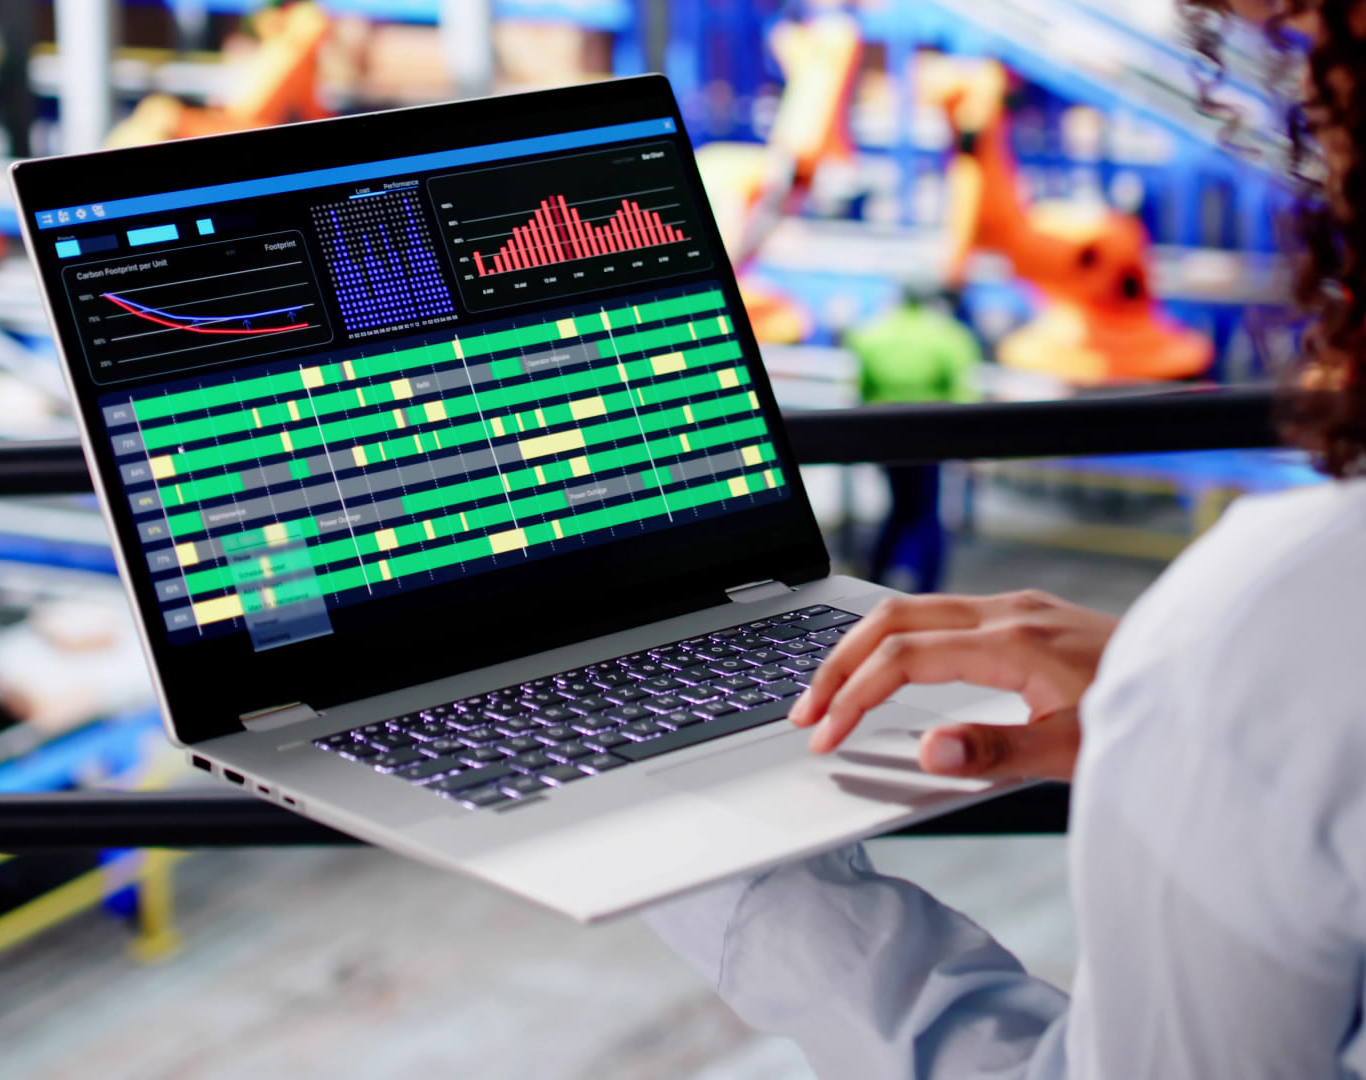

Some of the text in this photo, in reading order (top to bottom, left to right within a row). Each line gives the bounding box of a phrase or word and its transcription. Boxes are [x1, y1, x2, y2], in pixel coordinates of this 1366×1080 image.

[383, 179, 419, 190] Performance
[355, 187, 371, 195] Load
[263, 239, 297, 252] Footprint
[76, 258, 168, 281] Carbon Footprint per Unit
[78, 293, 94, 302] 100%
[586, 487, 608, 497] Outage
[319, 518, 337, 528] Power
